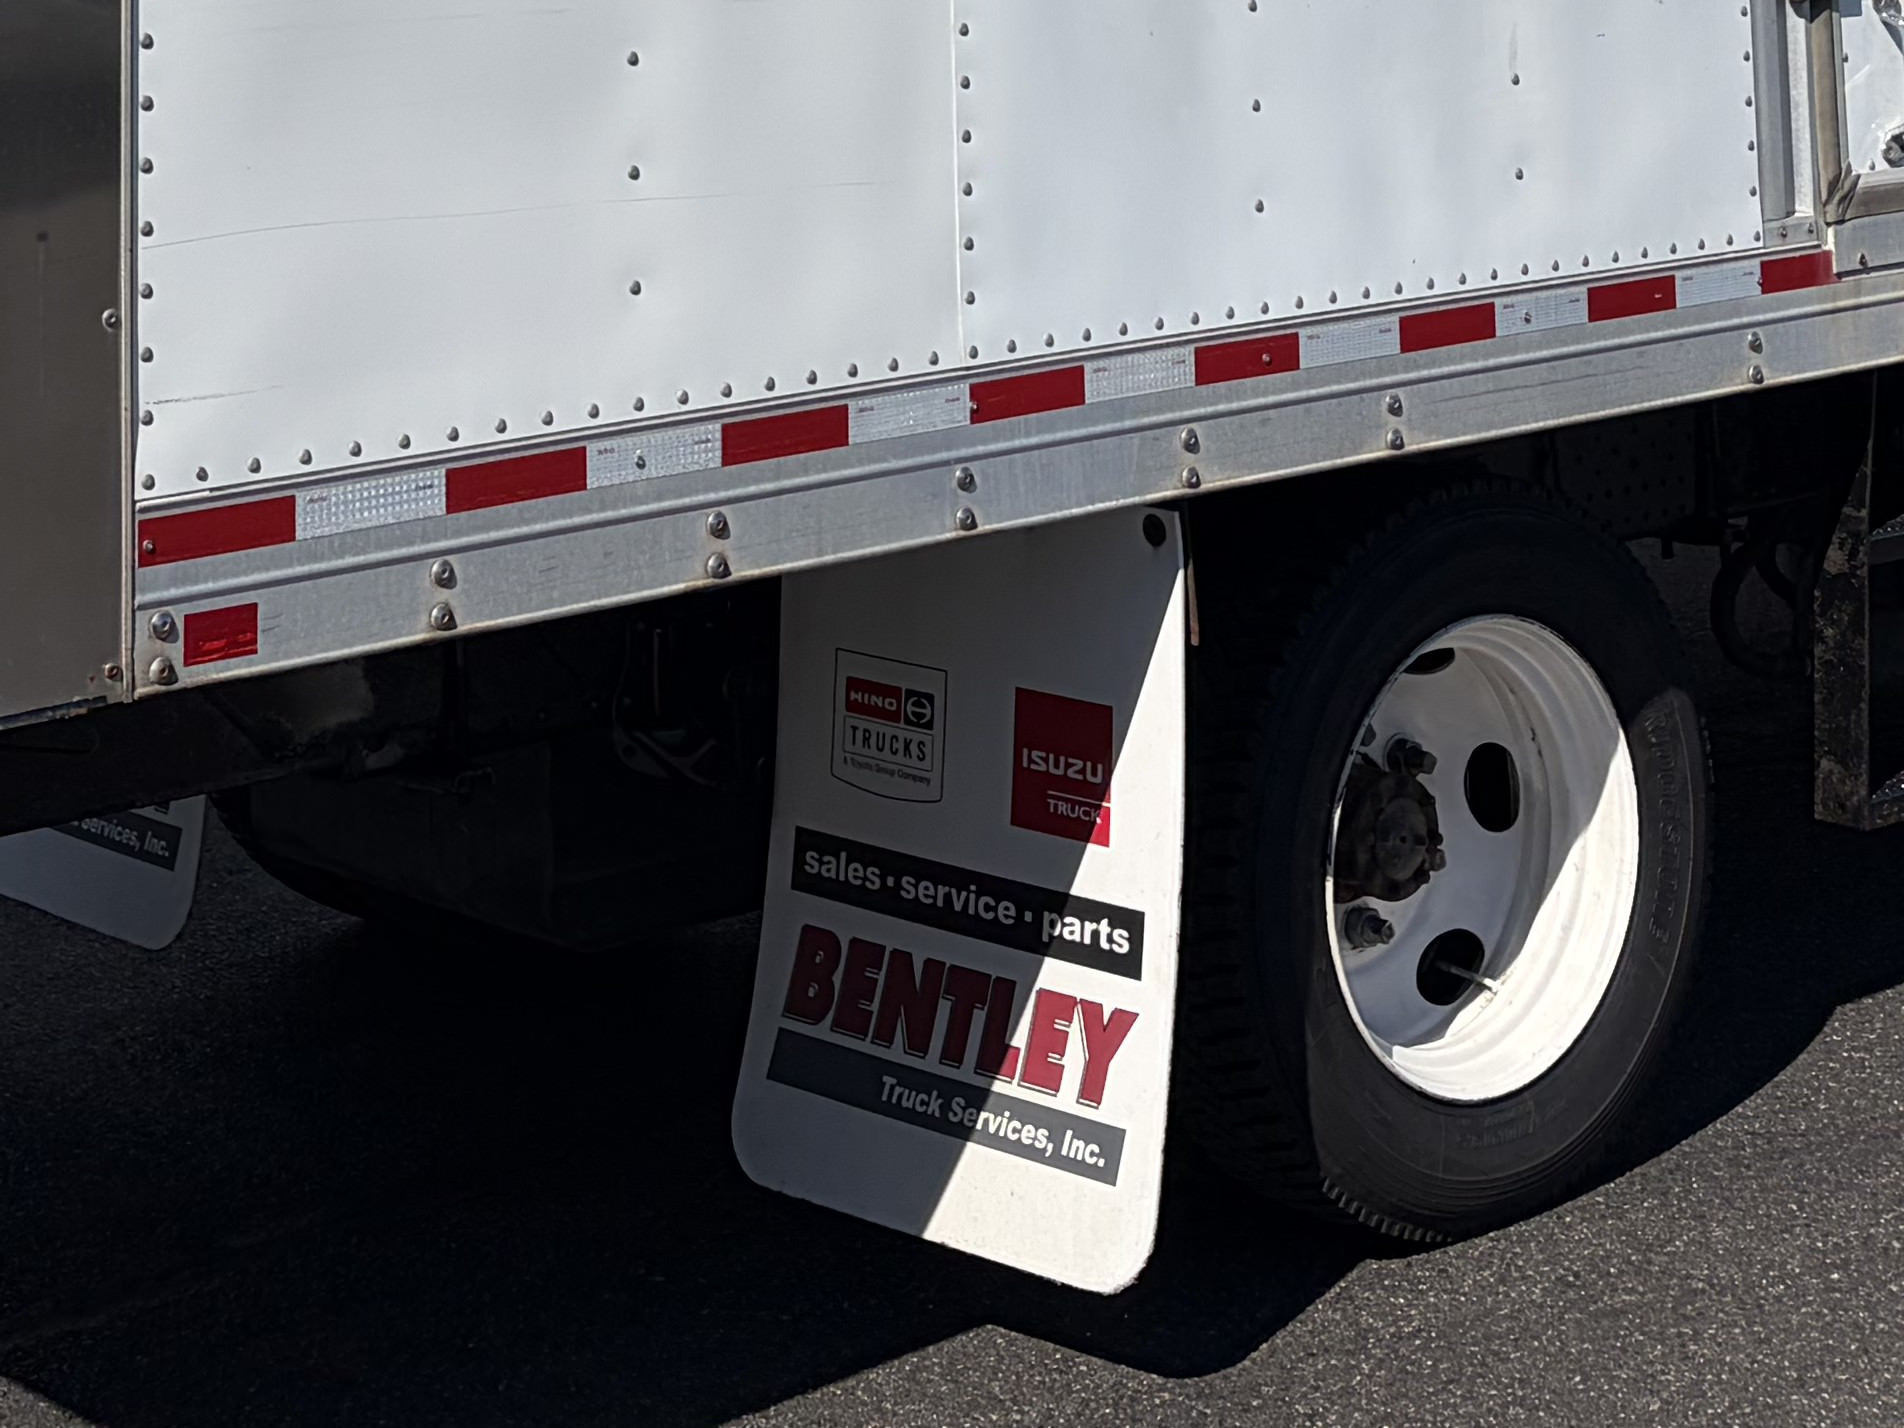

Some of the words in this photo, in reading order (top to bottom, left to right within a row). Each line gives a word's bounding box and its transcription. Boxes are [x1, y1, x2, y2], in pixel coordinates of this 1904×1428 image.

[849, 690, 898, 712] HINO
[849, 725, 927, 762] TRUCKS
[1022, 747, 1103, 784] ISUZU
[1047, 799, 1102, 824] TRUCK
[804, 850, 881, 890] sales
[899, 875, 1016, 925] service
[1042, 910, 1131, 955] parts
[782, 923, 1140, 1110] BENTLEY
[880, 1075, 942, 1118] Truck
[947, 1097, 1054, 1157] Services,
[1060, 1128, 1106, 1168] Inc.
